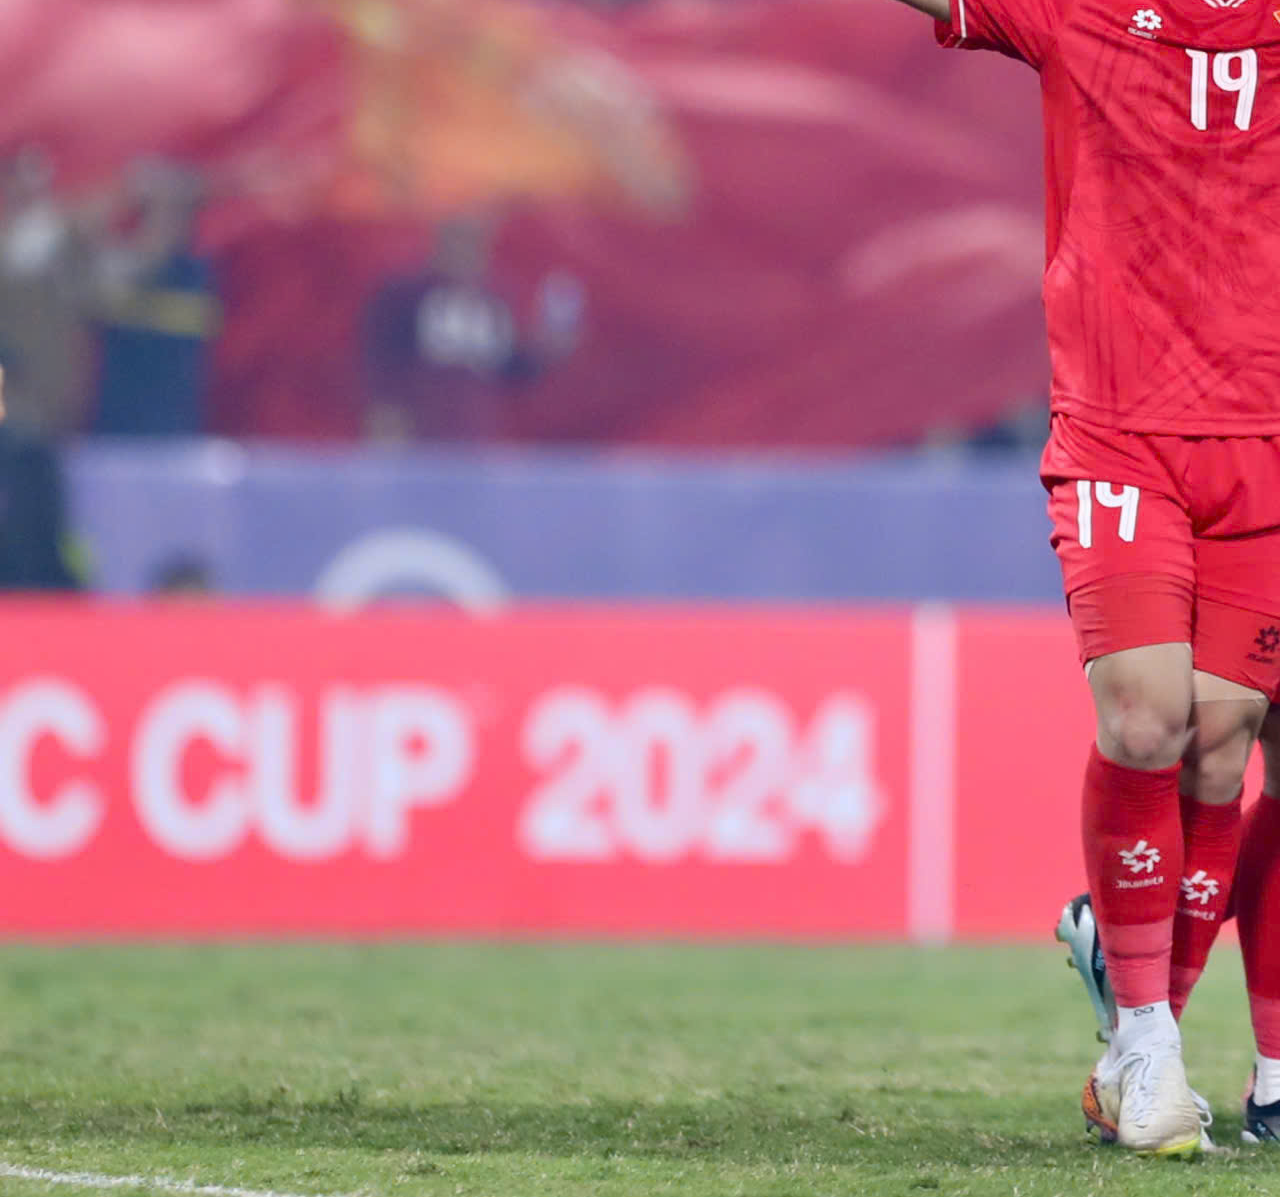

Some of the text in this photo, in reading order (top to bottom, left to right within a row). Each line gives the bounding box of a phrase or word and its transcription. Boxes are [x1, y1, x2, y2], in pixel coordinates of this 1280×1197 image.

[1186, 49, 1258, 131] 19
[0, 678, 884, 860] C CUP 2024
